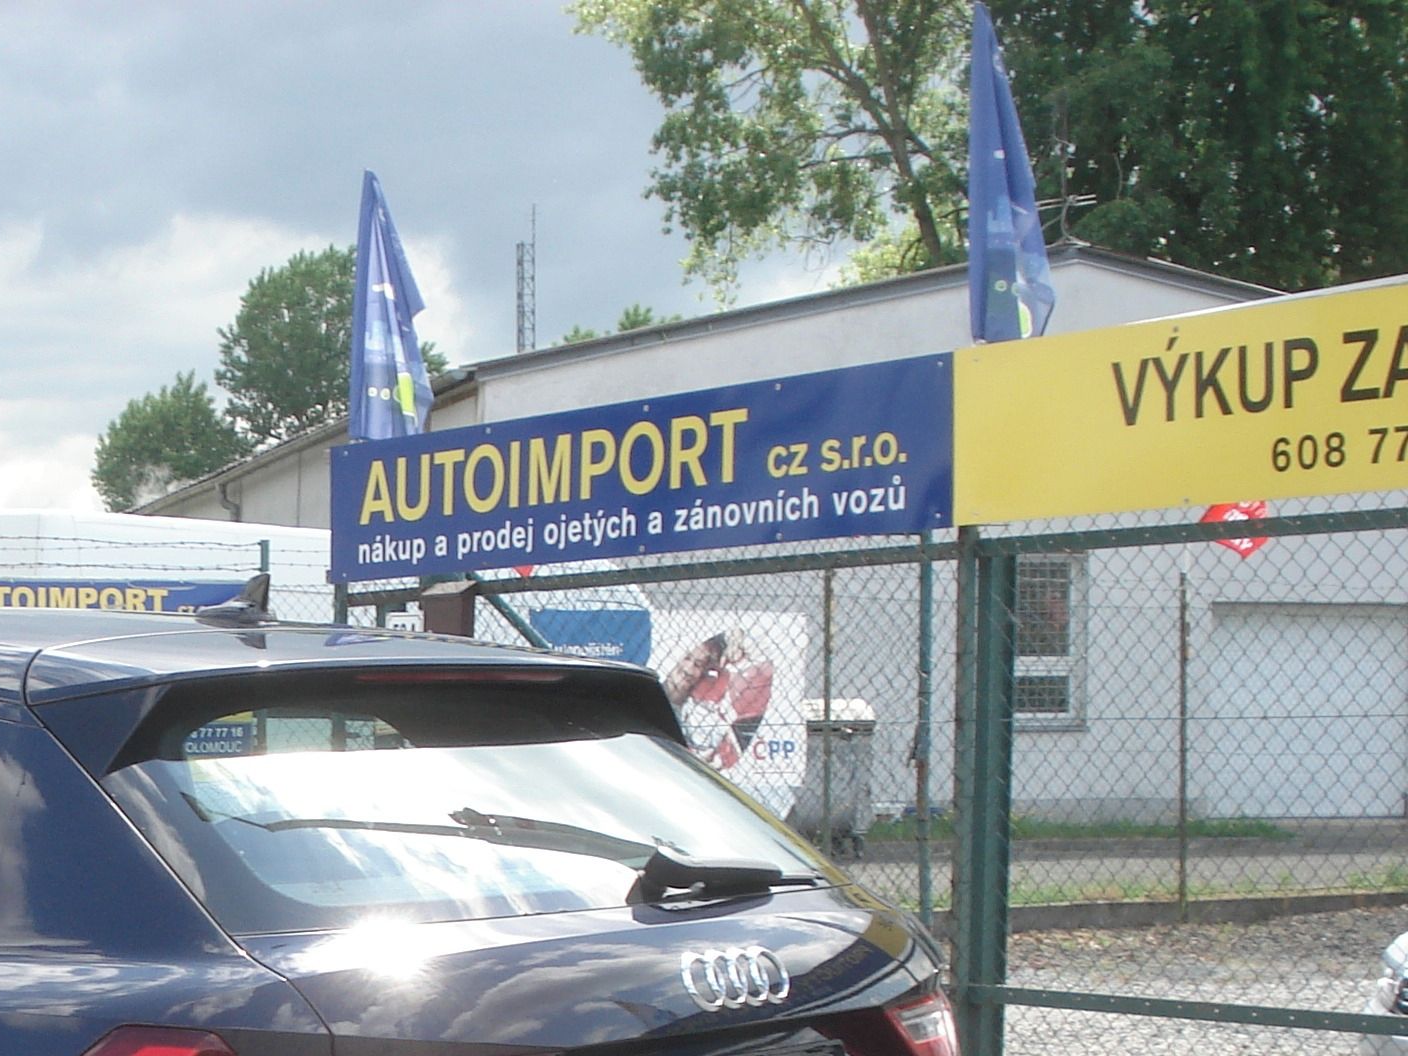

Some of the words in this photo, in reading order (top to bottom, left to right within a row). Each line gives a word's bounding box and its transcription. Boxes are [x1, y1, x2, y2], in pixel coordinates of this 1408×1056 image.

[1111, 335, 1320, 427] VÝKUP
[359, 407, 749, 526] AUTOIMPORT
[766, 442, 809, 478] cz
[819, 431, 908, 473] s.r.o.
[1271, 431, 1346, 473] 608
[357, 534, 426, 565] nákup
[434, 534, 448, 557] a
[456, 516, 535, 560] prodej
[542, 506, 637, 550] ojetých
[647, 510, 664, 534] a
[673, 486, 820, 533] zánovních
[831, 473, 907, 517] vozů
[752, 736, 796, 761] ČPP
